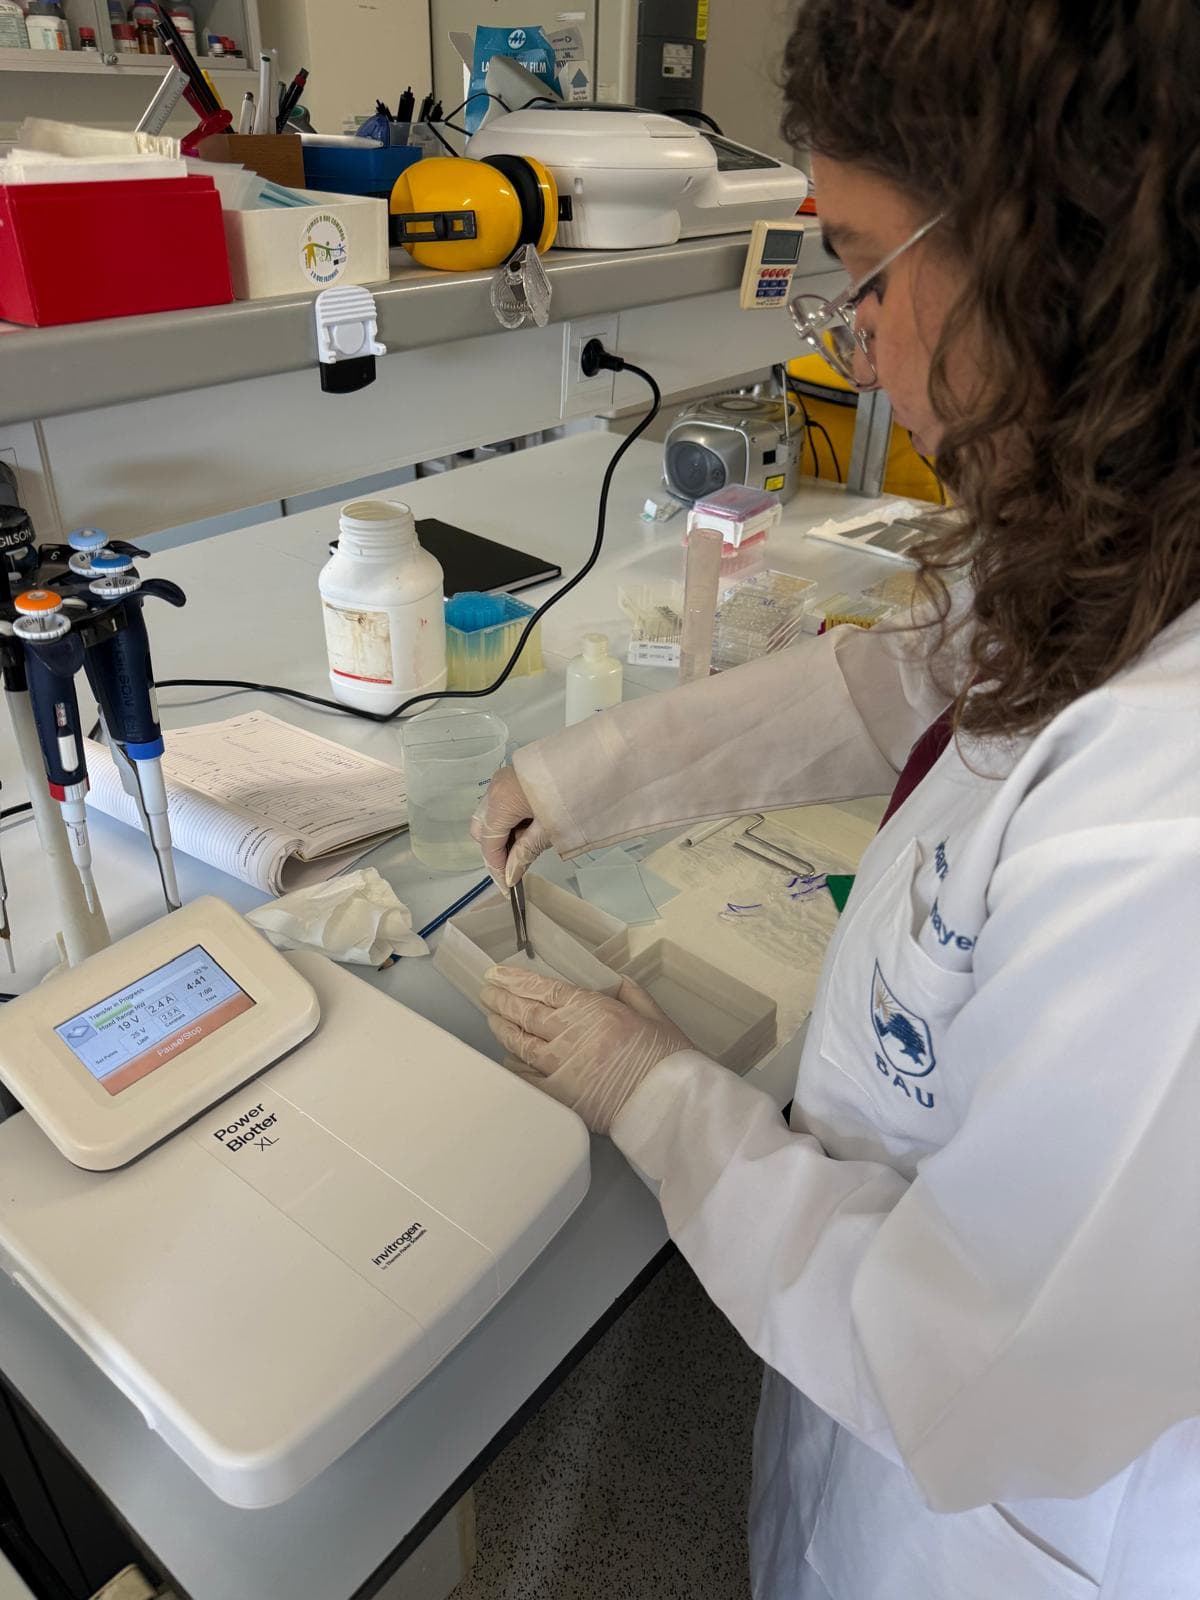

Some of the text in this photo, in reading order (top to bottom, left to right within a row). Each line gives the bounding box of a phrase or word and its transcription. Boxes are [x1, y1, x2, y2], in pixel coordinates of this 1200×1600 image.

[529, 61, 547, 73] FILM
[0, 528, 31, 548] GILSON
[186, 976, 207, 990] 4:41
[90, 1005, 113, 1021] Transfer
[119, 987, 145, 1004] Progress
[148, 995, 174, 1014] 2.4 A
[98, 1020, 116, 1032] Mixed
[116, 1008, 134, 1022] Range
[118, 1015, 140, 1032] 19 V
[156, 1026, 202, 1056] Pause/Stop
[875, 1051, 934, 1109] BAU
[214, 1104, 264, 1142] Power
[226, 1113, 277, 1152] Blotter
[254, 1136, 280, 1152] XL
[372, 1222, 422, 1266] invitrogen
